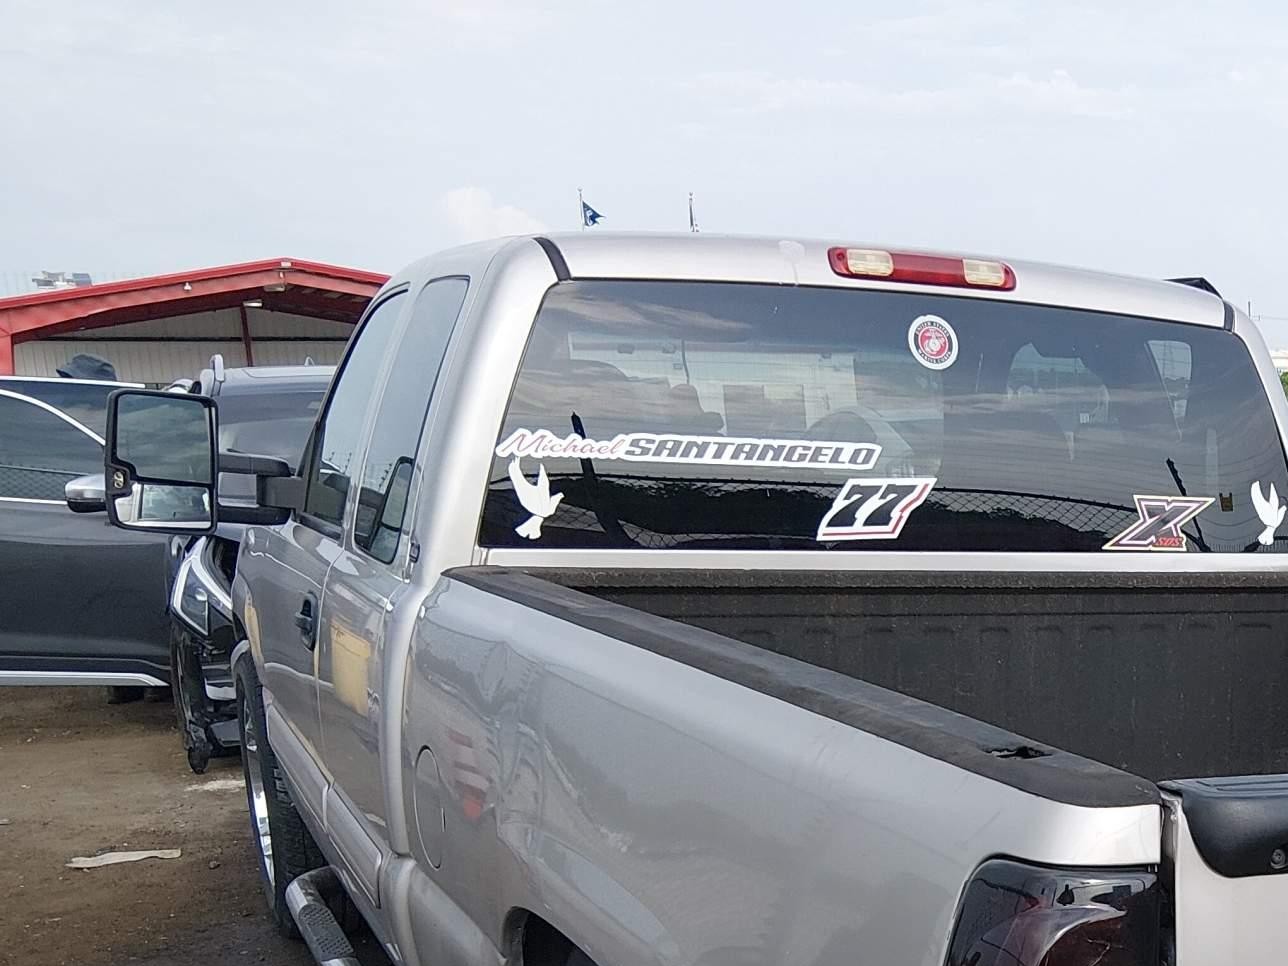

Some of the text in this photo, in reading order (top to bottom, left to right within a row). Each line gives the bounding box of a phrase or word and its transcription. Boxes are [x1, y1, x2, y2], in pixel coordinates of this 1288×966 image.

[501, 433, 875, 465] Michael SANTANGELO
[823, 482, 921, 530] 77
